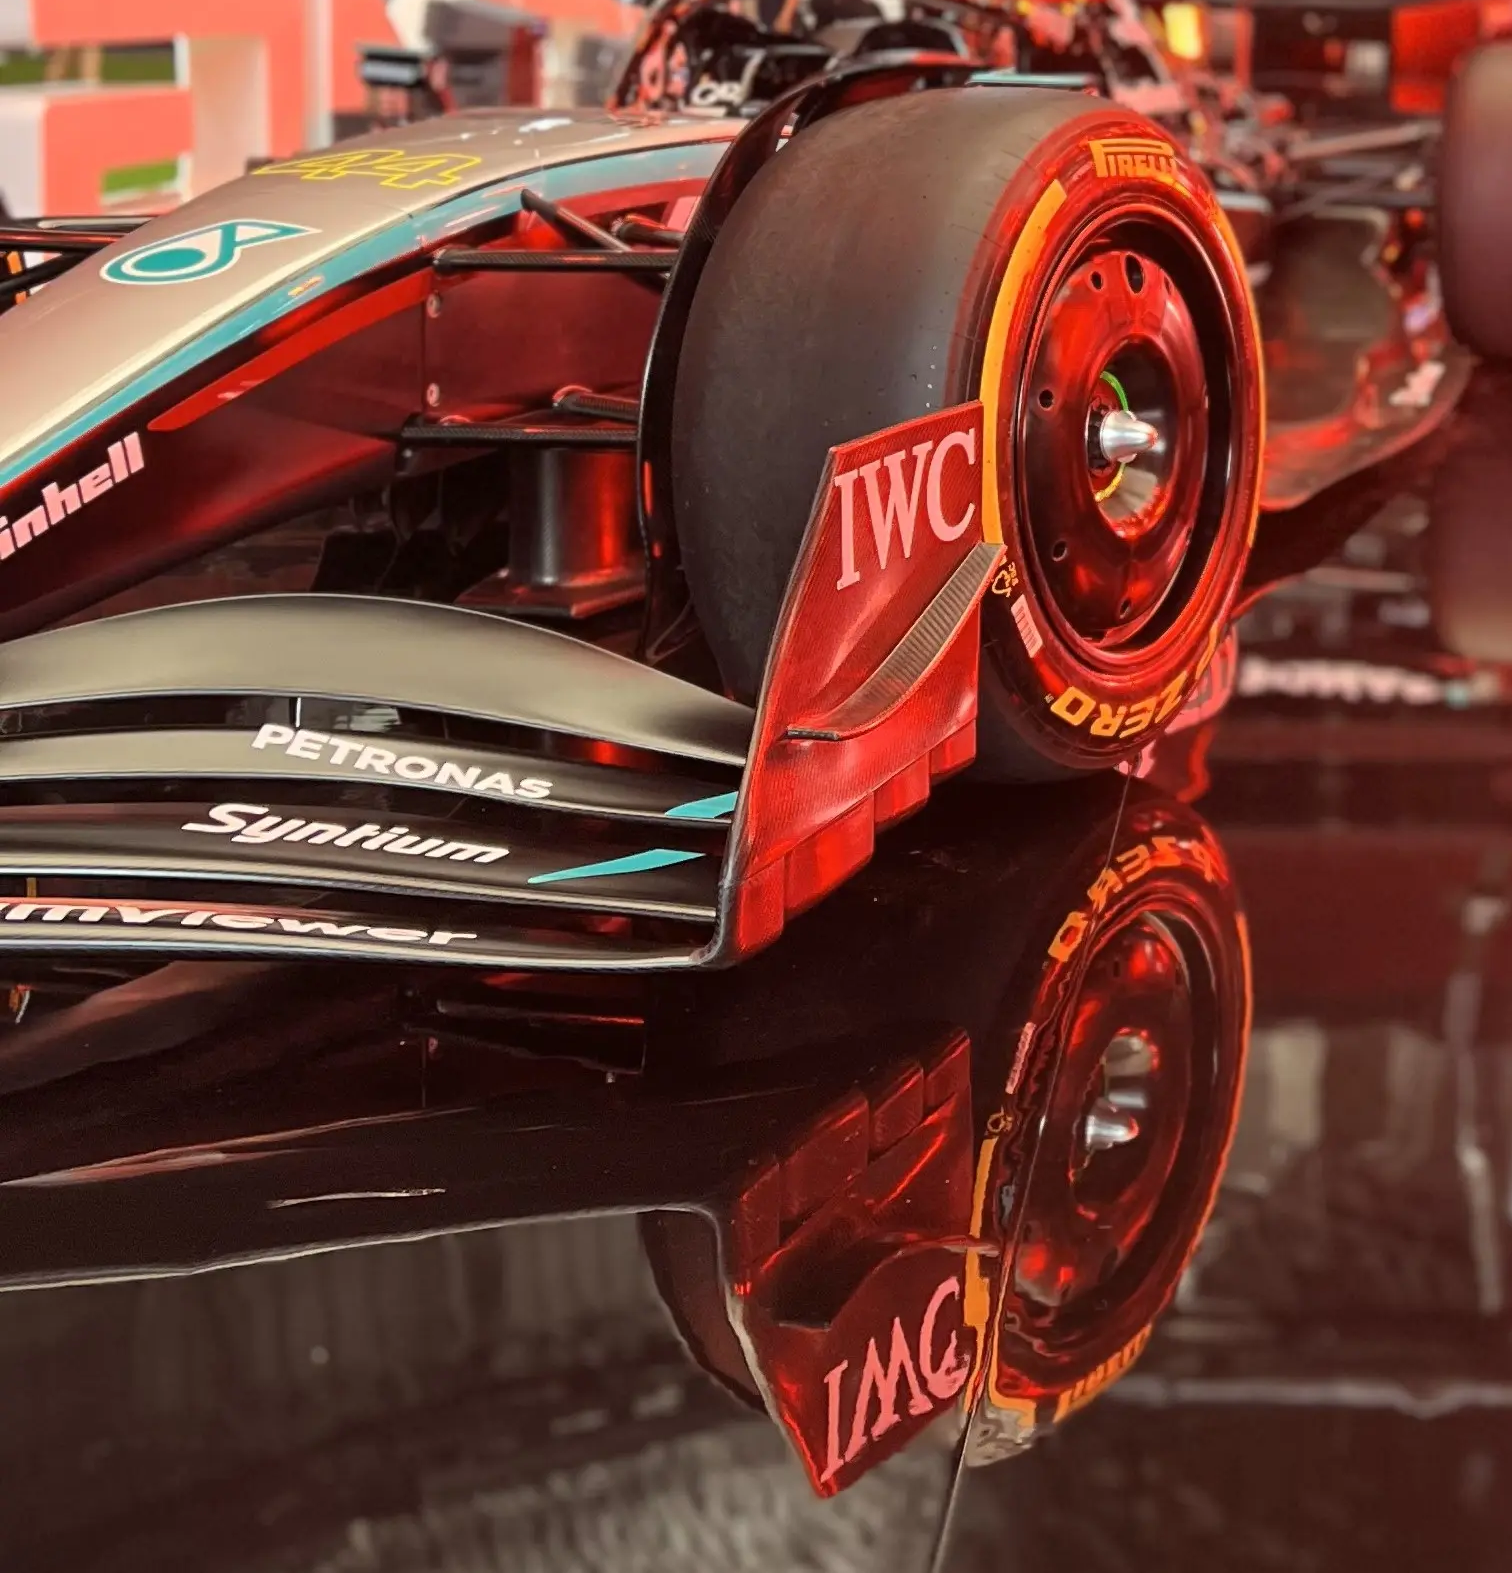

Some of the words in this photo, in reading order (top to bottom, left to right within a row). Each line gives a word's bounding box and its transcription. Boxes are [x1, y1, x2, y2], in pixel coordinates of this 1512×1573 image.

[252, 148, 483, 190] 44
[1087, 137, 1178, 179] PIRELLI
[833, 427, 976, 591] IWC
[1050, 668, 1188, 739] ZERO
[250, 723, 554, 800] PETRONAS
[180, 803, 511, 864] Syntium
